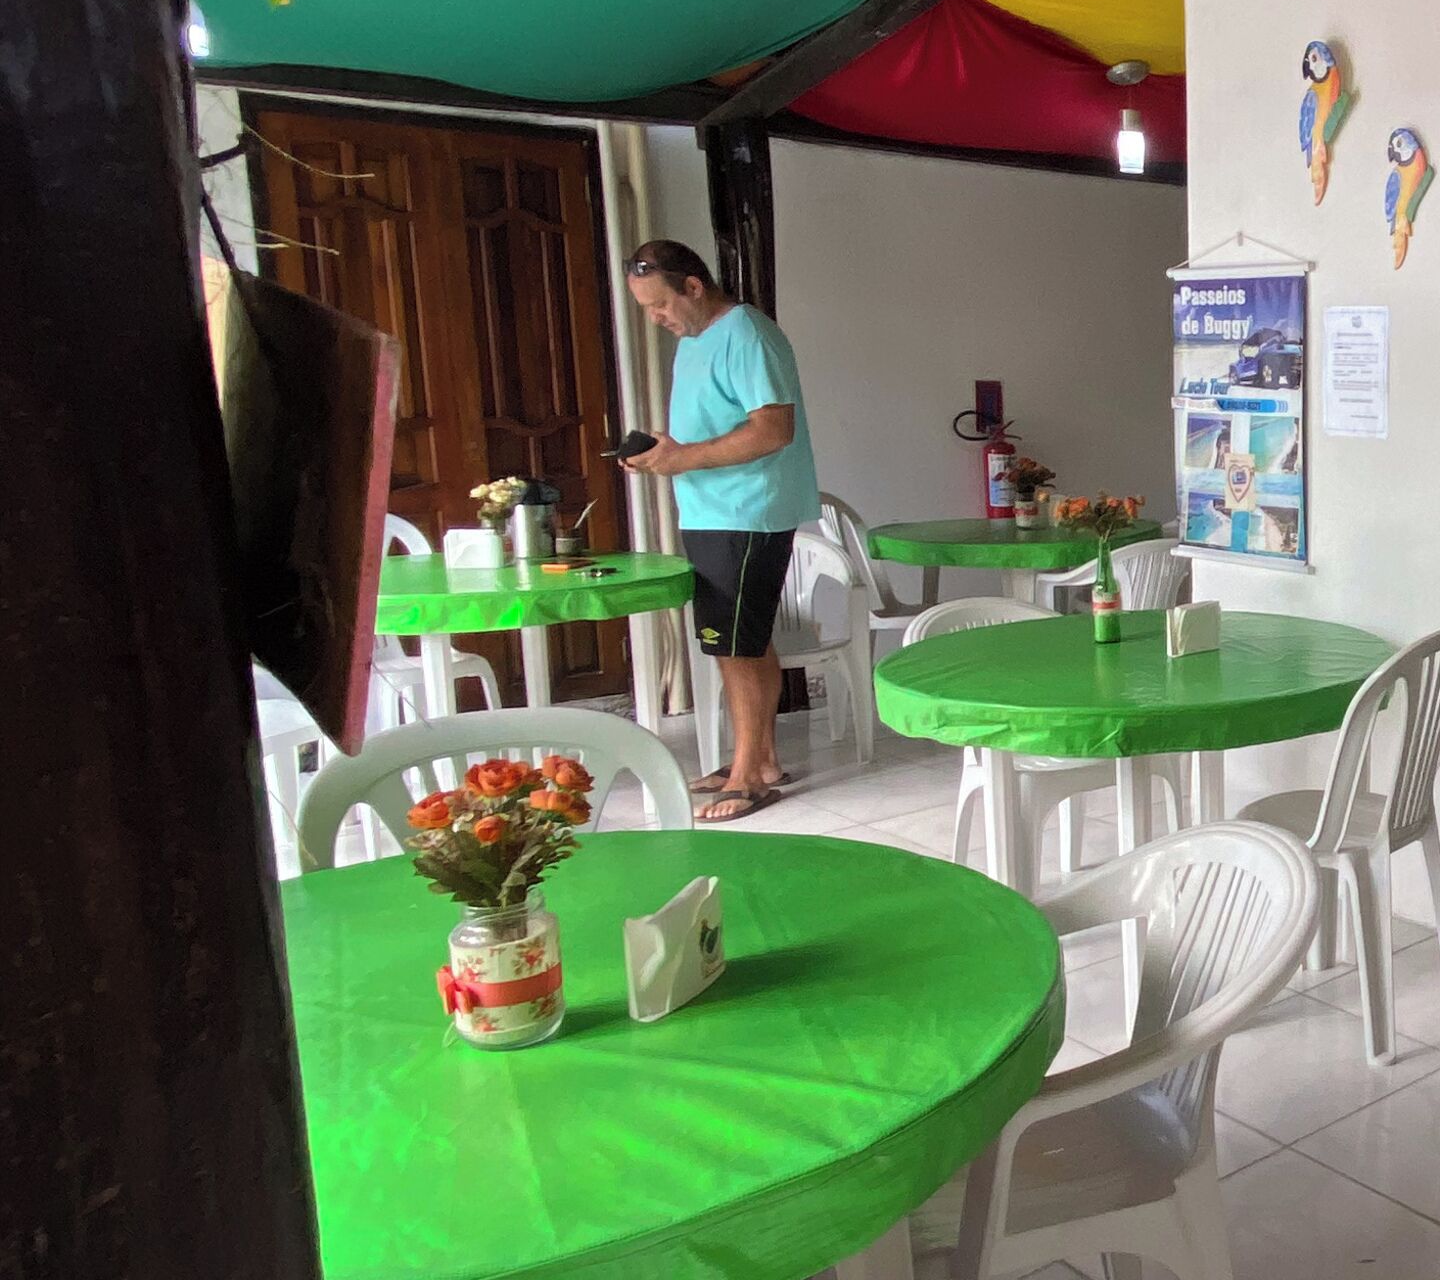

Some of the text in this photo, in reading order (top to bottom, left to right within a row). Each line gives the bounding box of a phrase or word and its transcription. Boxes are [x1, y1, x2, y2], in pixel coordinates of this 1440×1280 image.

[1180, 285, 1246, 306] Passeios
[1181, 314, 1251, 340] de Buggy
